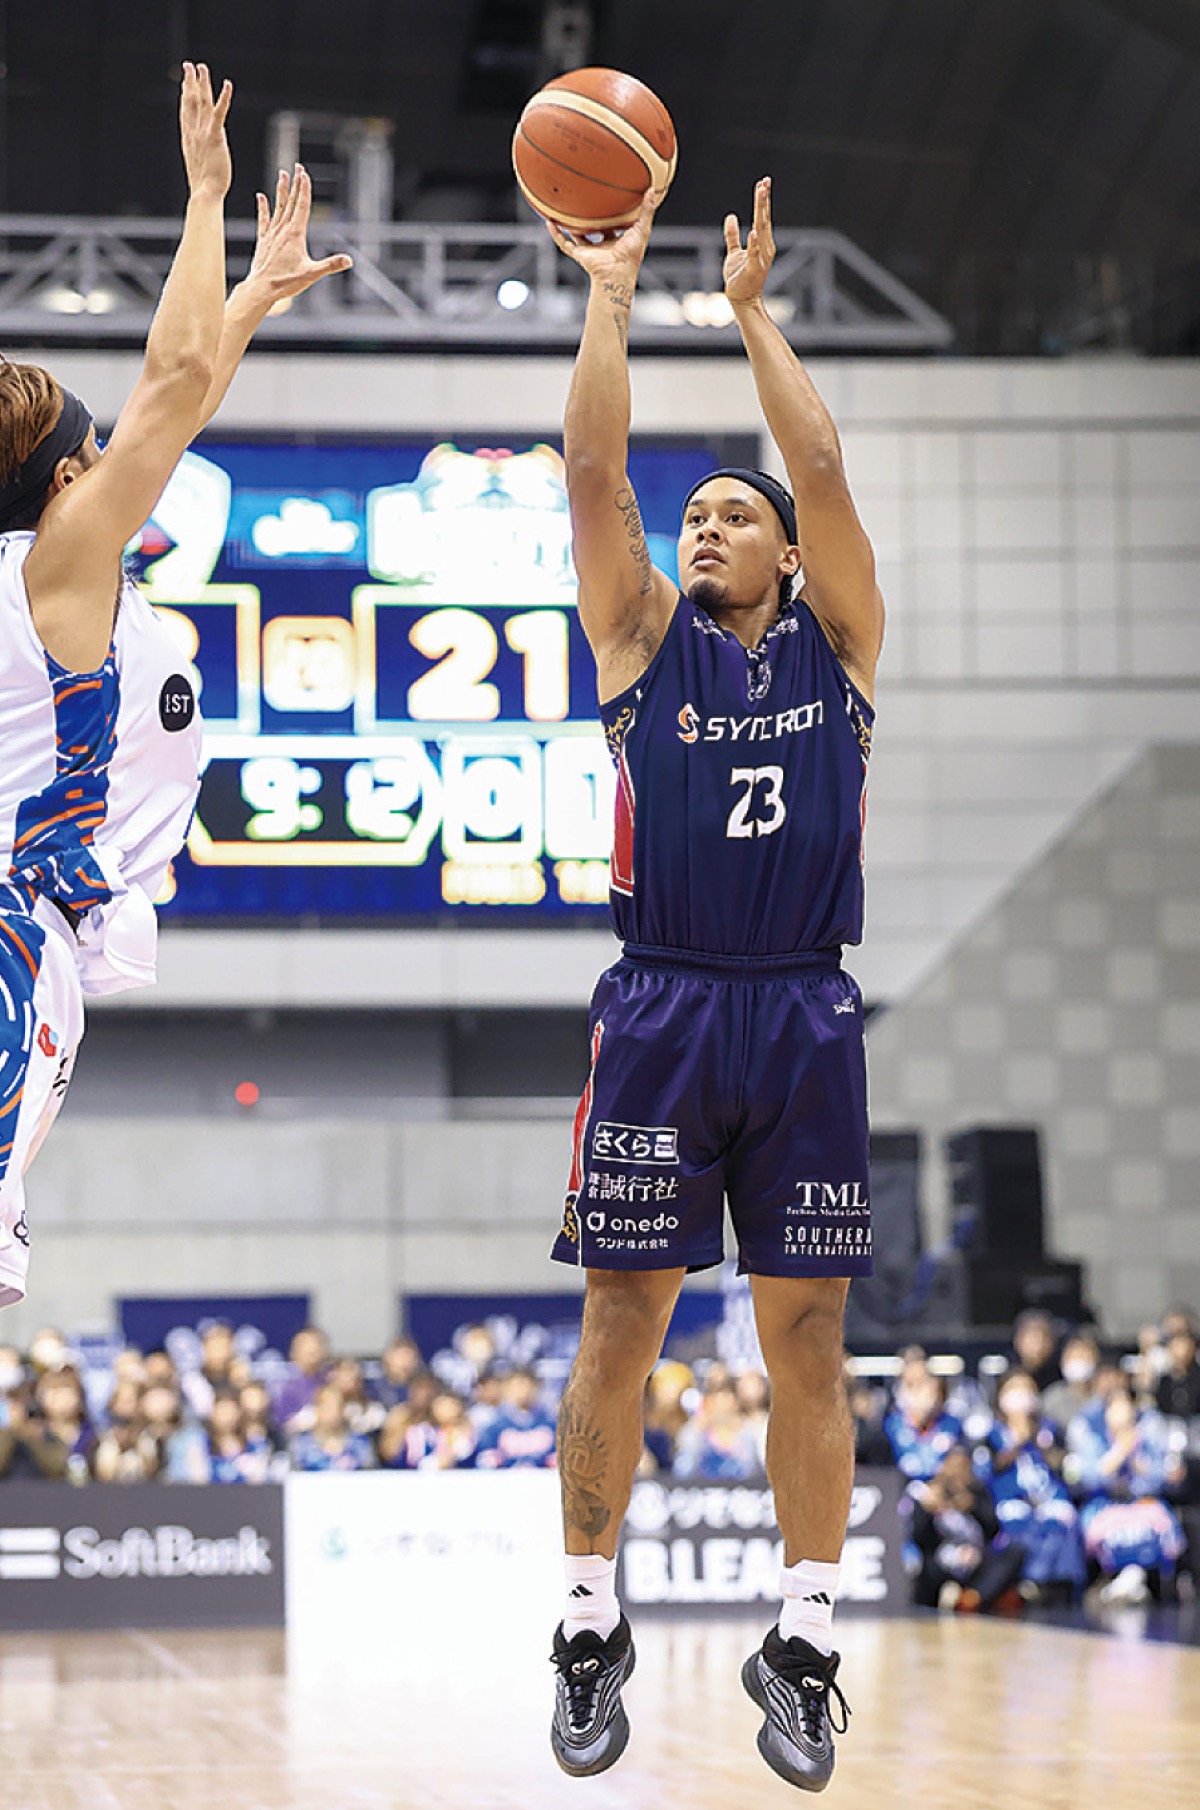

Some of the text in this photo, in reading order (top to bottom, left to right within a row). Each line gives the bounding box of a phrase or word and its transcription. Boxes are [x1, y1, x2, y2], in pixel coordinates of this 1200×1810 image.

[408, 608, 568, 722] 21
[726, 766, 787, 838] 23
[595, 1129, 651, 1158] さくら
[796, 1181, 868, 1207] TML
[610, 1212, 679, 1233] onedo
[63, 1526, 272, 1578] SoftBank
